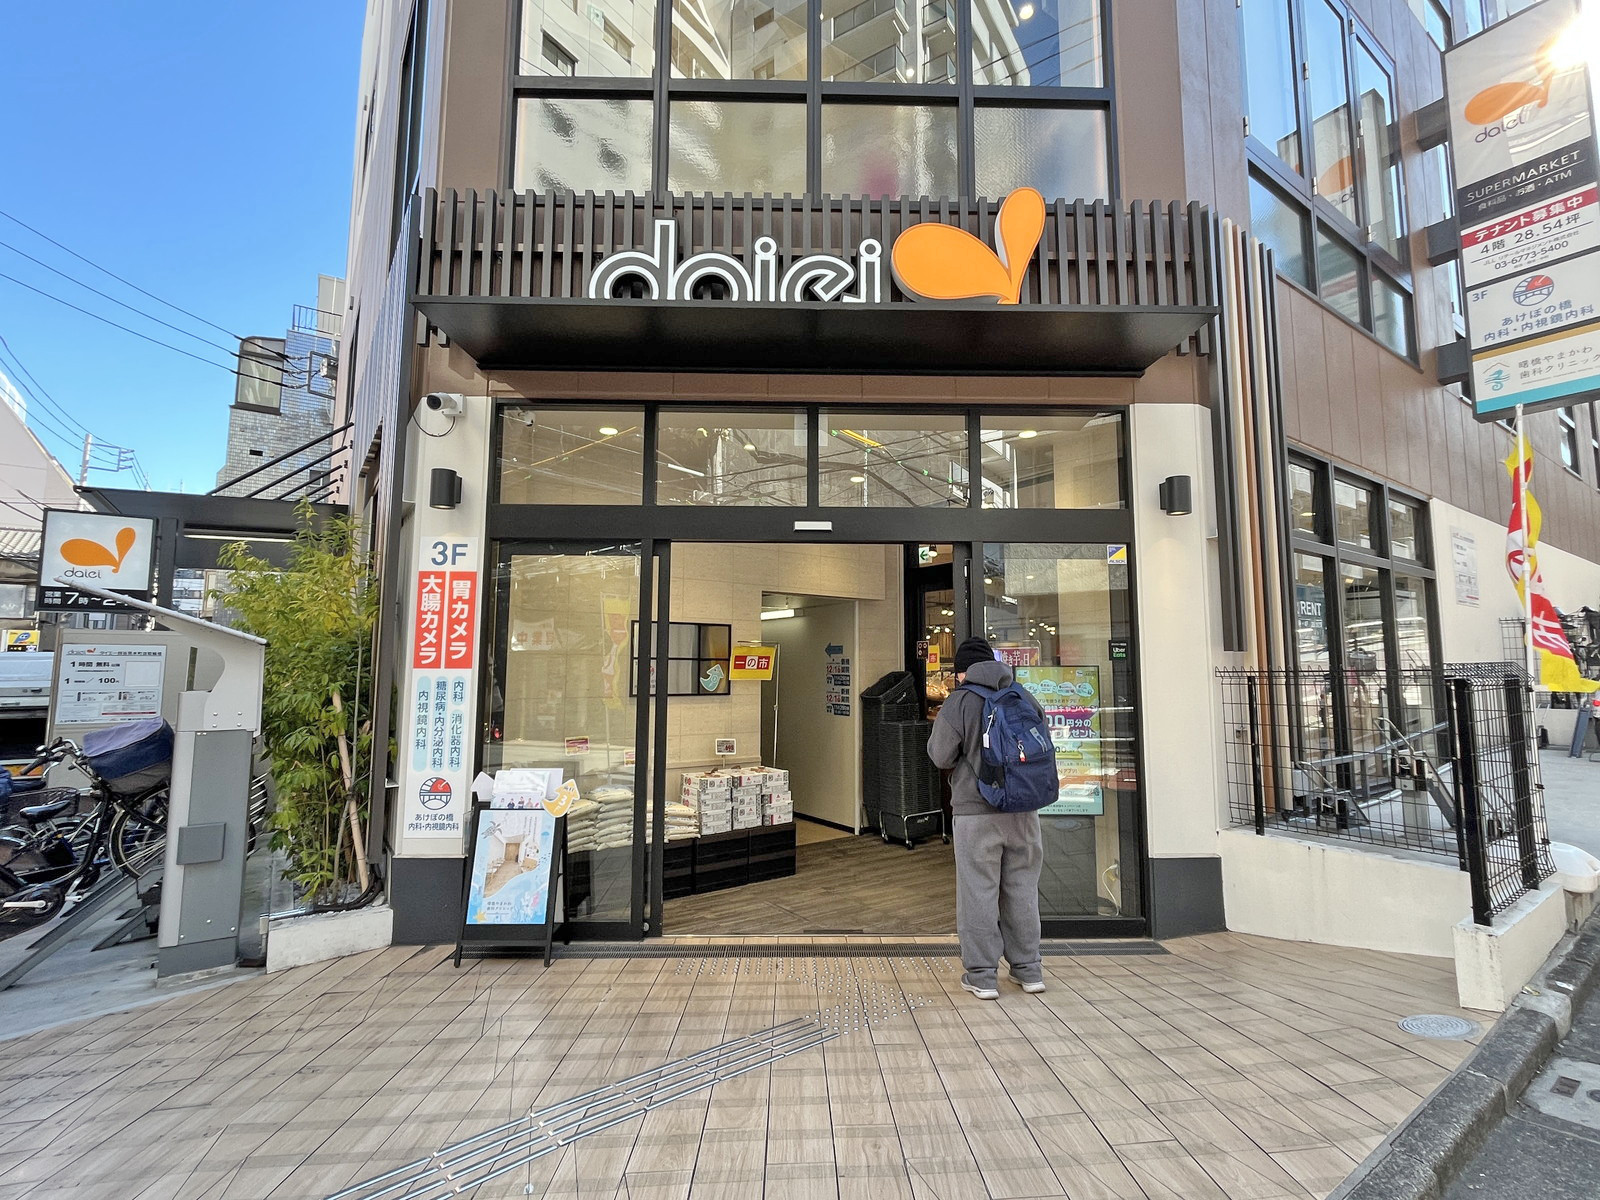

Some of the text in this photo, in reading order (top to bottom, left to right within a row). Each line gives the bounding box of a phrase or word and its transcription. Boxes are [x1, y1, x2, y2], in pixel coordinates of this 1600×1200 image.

[1467, 150, 1580, 201] SUPERMARKET
[1475, 196, 1583, 242] テナント募集中
[1480, 212, 1580, 254] 4階 28.54坪
[588, 219, 881, 303] daiei
[1494, 240, 1569, 270] 03-6773-5400
[1472, 290, 1488, 302] 3F
[1502, 299, 1572, 326] あけぼの橋
[1483, 304, 1594, 342] 内科・内視鏡内科
[430, 541, 468, 566] 3F
[64, 567, 102, 579] daiei
[418, 574, 443, 664] 大腸カメラ
[449, 580, 472, 660] 胃カメラ
[1300, 600, 1322, 616] RENT
[734, 657, 769, 670] 一の市
[415, 690, 429, 750] 内視鏡内科
[432, 681, 447, 768] 糖尿病・内分泌内科
[449, 681, 464, 768] 内科 消化器内科
[408, 822, 459, 831] 内科・内視鏡内科
[414, 813, 453, 821] あけぼの橋
